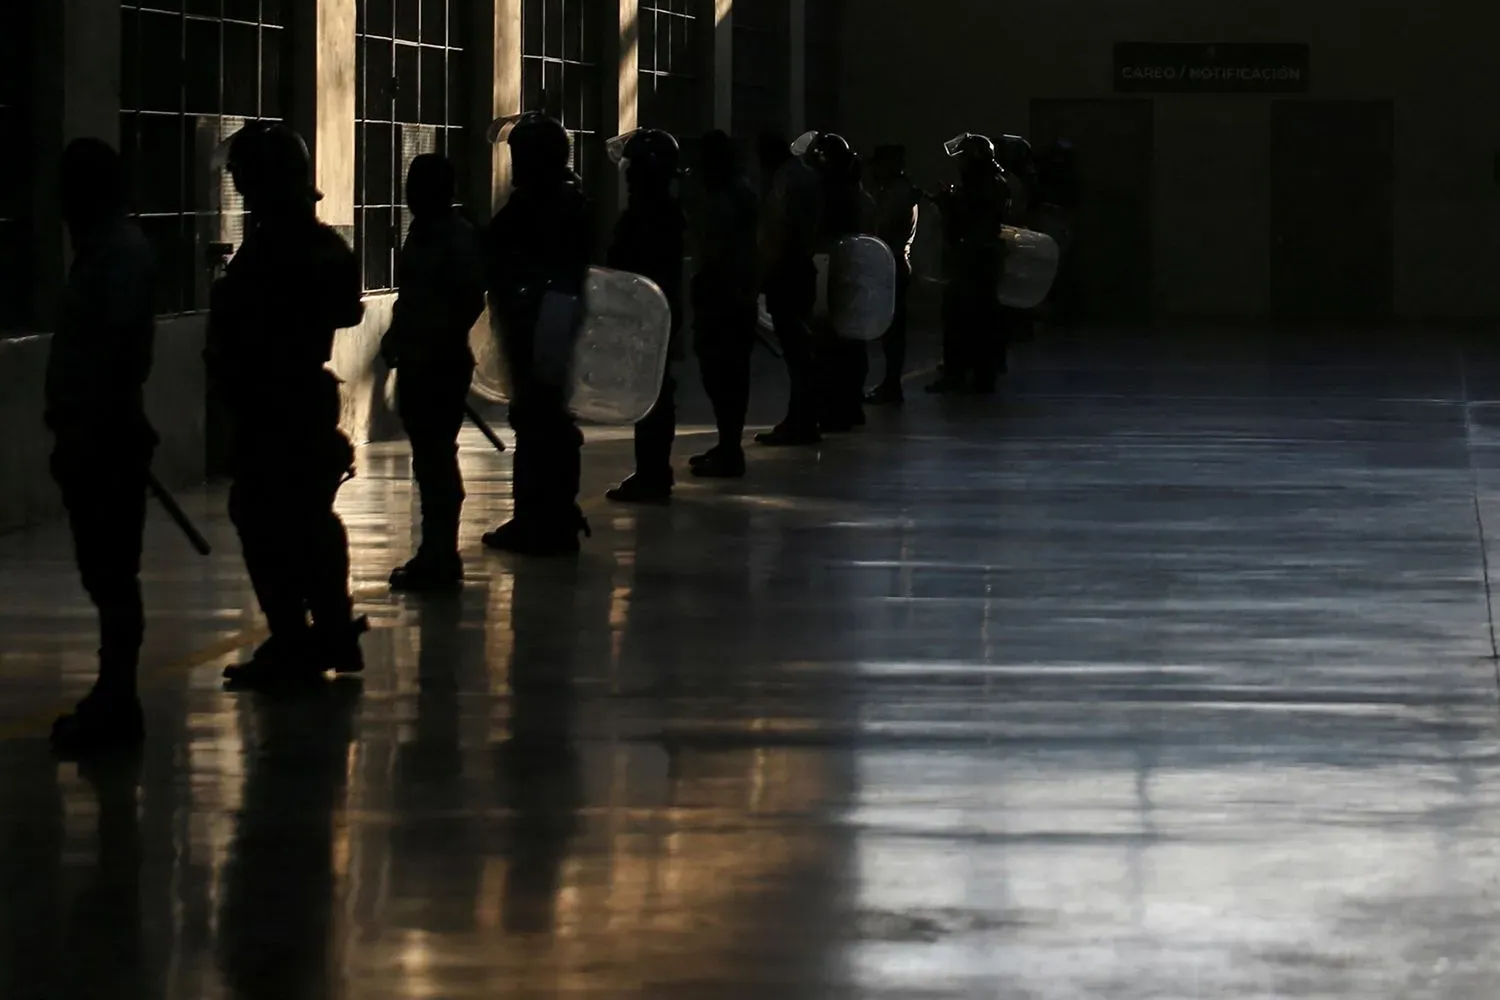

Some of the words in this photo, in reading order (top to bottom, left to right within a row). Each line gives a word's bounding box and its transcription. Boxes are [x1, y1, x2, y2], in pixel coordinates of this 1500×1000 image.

[1122, 65, 1176, 80] CAREO
[1179, 65, 1188, 80] /
[1189, 64, 1300, 81] NOTIFICACIÓN
